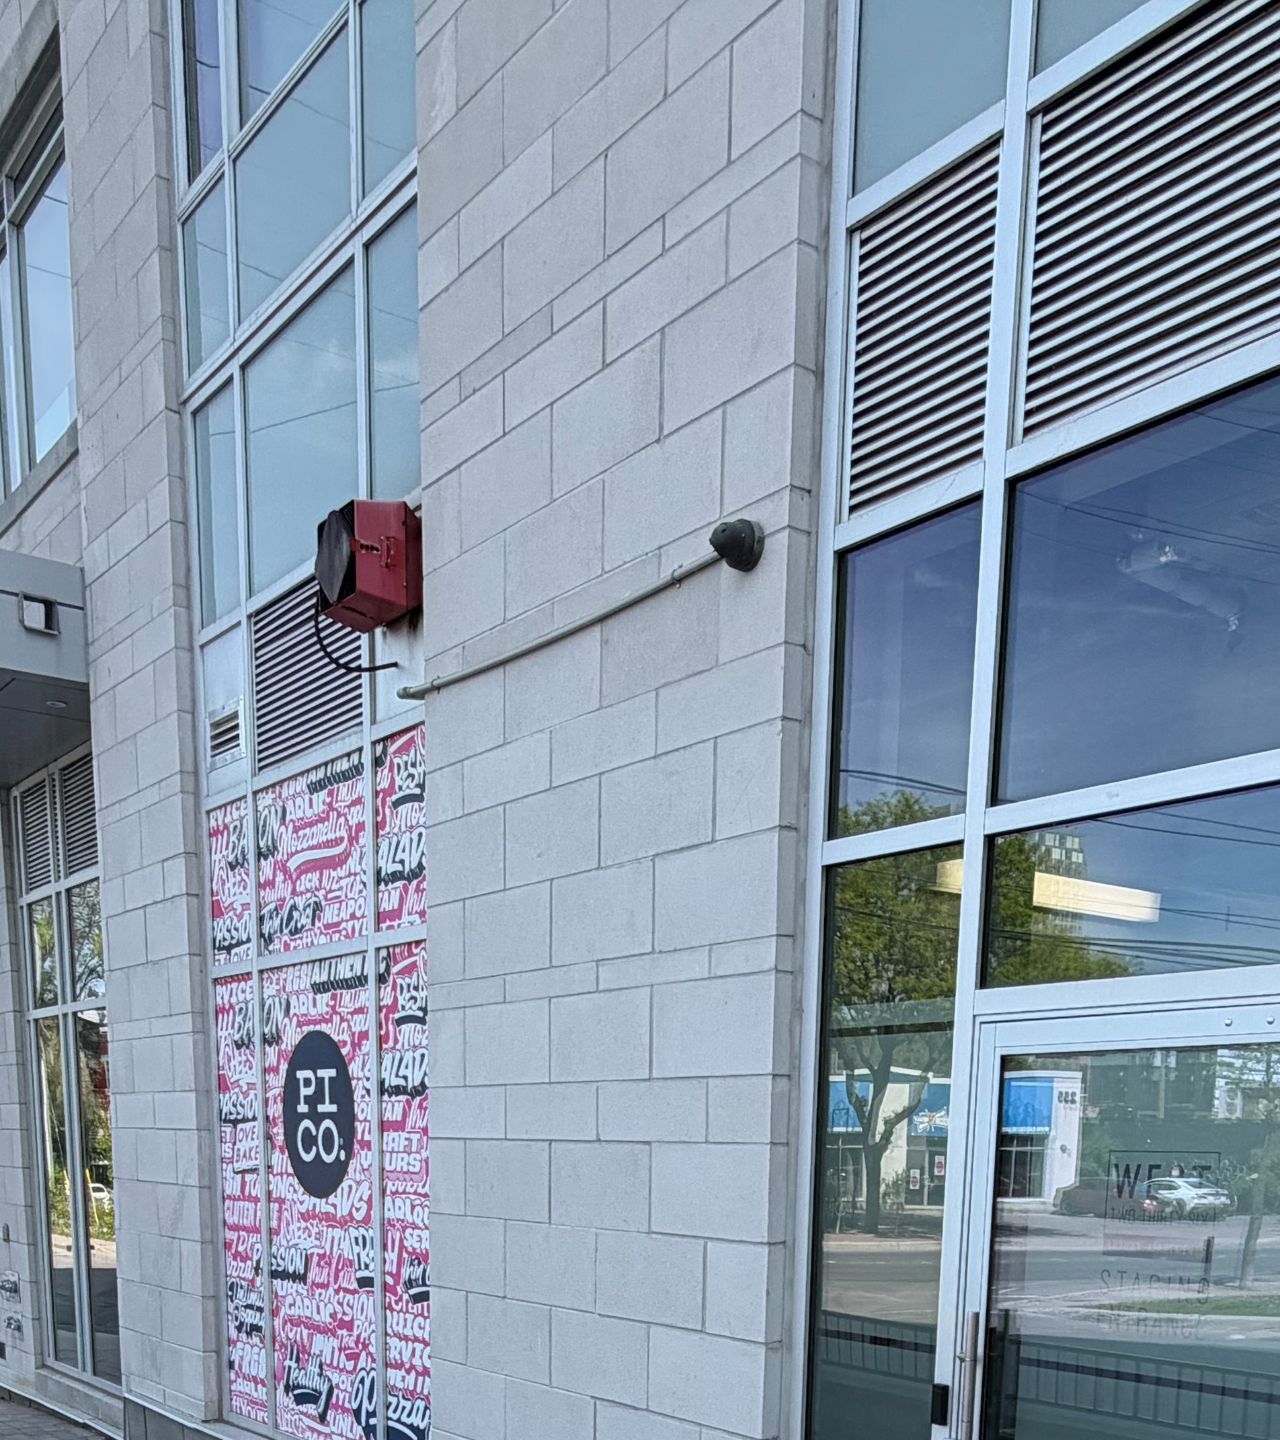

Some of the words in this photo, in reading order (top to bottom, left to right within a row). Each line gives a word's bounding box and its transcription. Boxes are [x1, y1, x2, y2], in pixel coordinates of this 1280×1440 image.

[278, 811, 347, 863] Mozzarella
[296, 1068, 338, 1113] PI
[284, 1341, 329, 1417] Healthy
